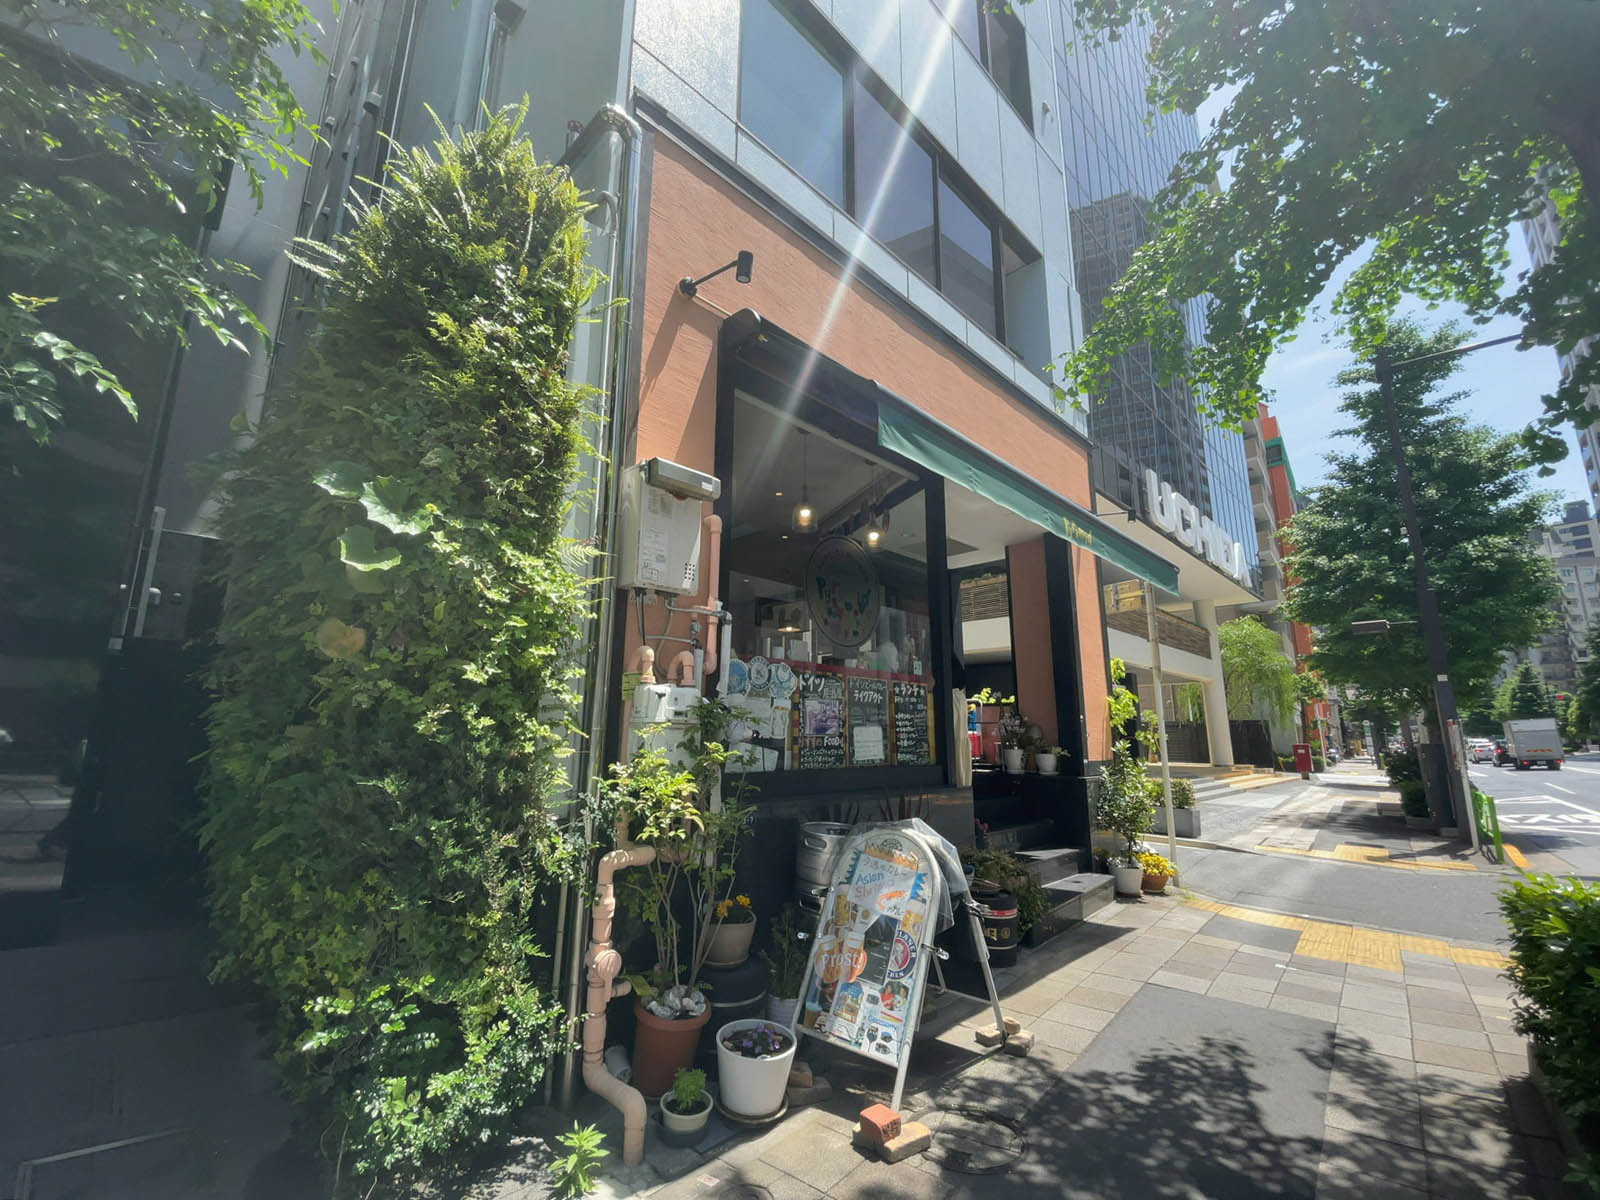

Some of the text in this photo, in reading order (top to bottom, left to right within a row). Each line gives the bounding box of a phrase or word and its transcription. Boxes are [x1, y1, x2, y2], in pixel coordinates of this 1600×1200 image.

[799, 673, 825, 692] ドイツ
[856, 872, 884, 885] Asian
